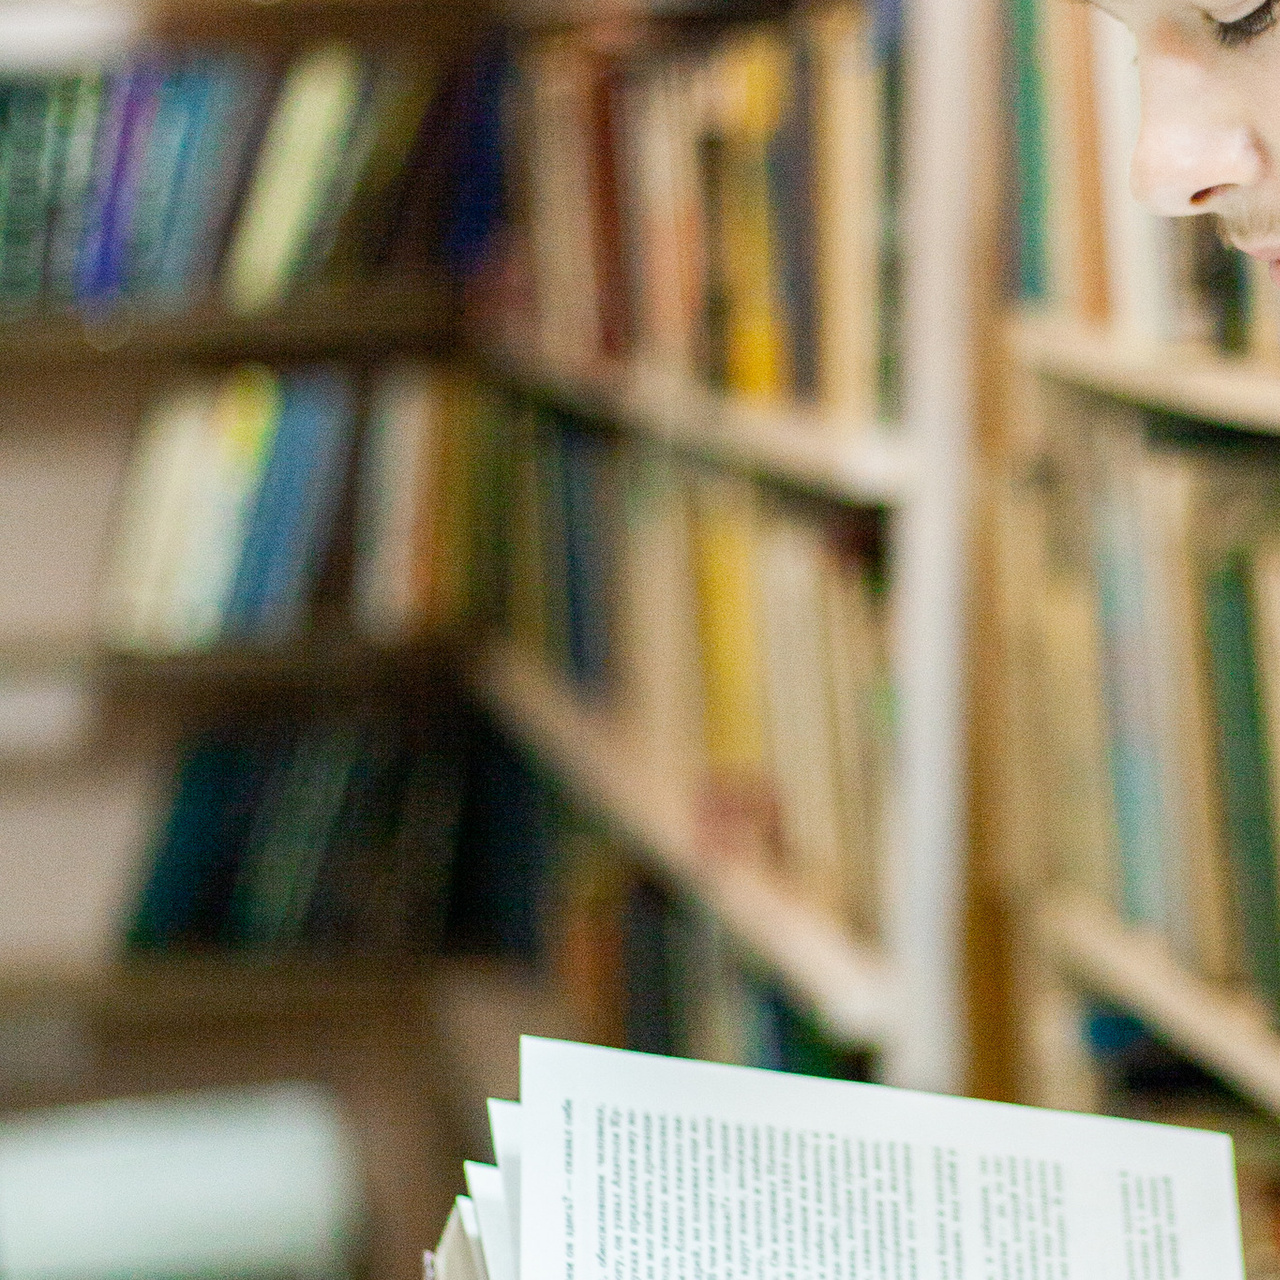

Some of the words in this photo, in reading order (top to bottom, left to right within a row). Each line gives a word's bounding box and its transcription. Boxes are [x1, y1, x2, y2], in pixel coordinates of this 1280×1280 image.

[563, 1241, 574, 1257] он
[612, 1235, 623, 1250] он
[644, 1264, 655, 1279] не
